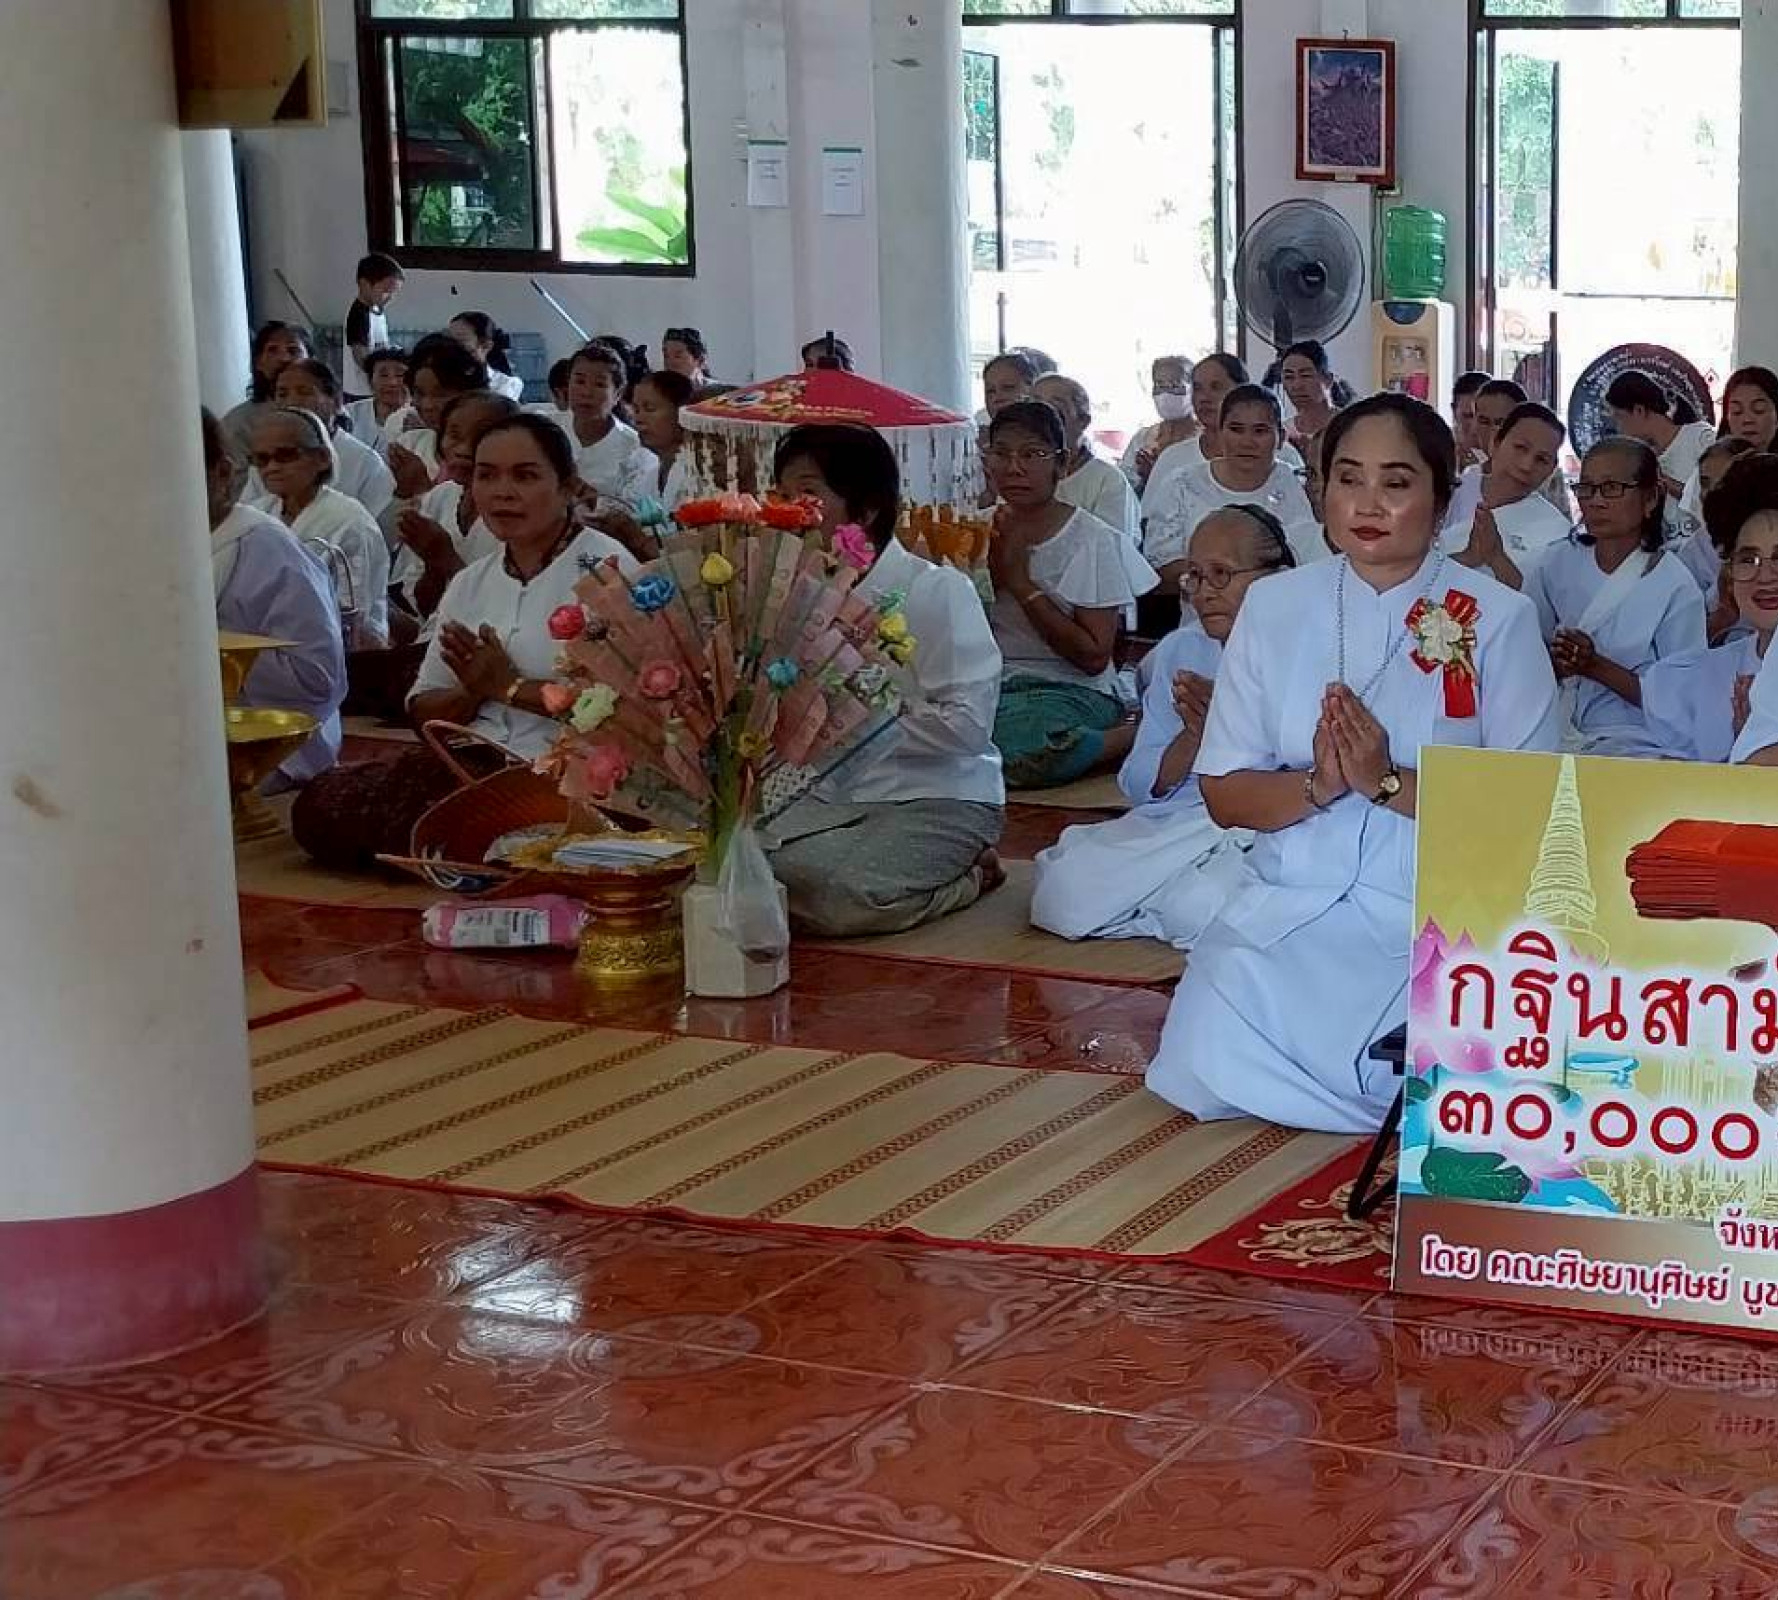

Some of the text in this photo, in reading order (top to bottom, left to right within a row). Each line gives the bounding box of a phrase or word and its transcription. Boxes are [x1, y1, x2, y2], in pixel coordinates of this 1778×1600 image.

[1438, 1088, 1760, 1161] ๓๐,๐๐๐
[1423, 1239, 1476, 1275] โดย
[1489, 1252, 1728, 1305] คณะศิษยานุศิษย์
